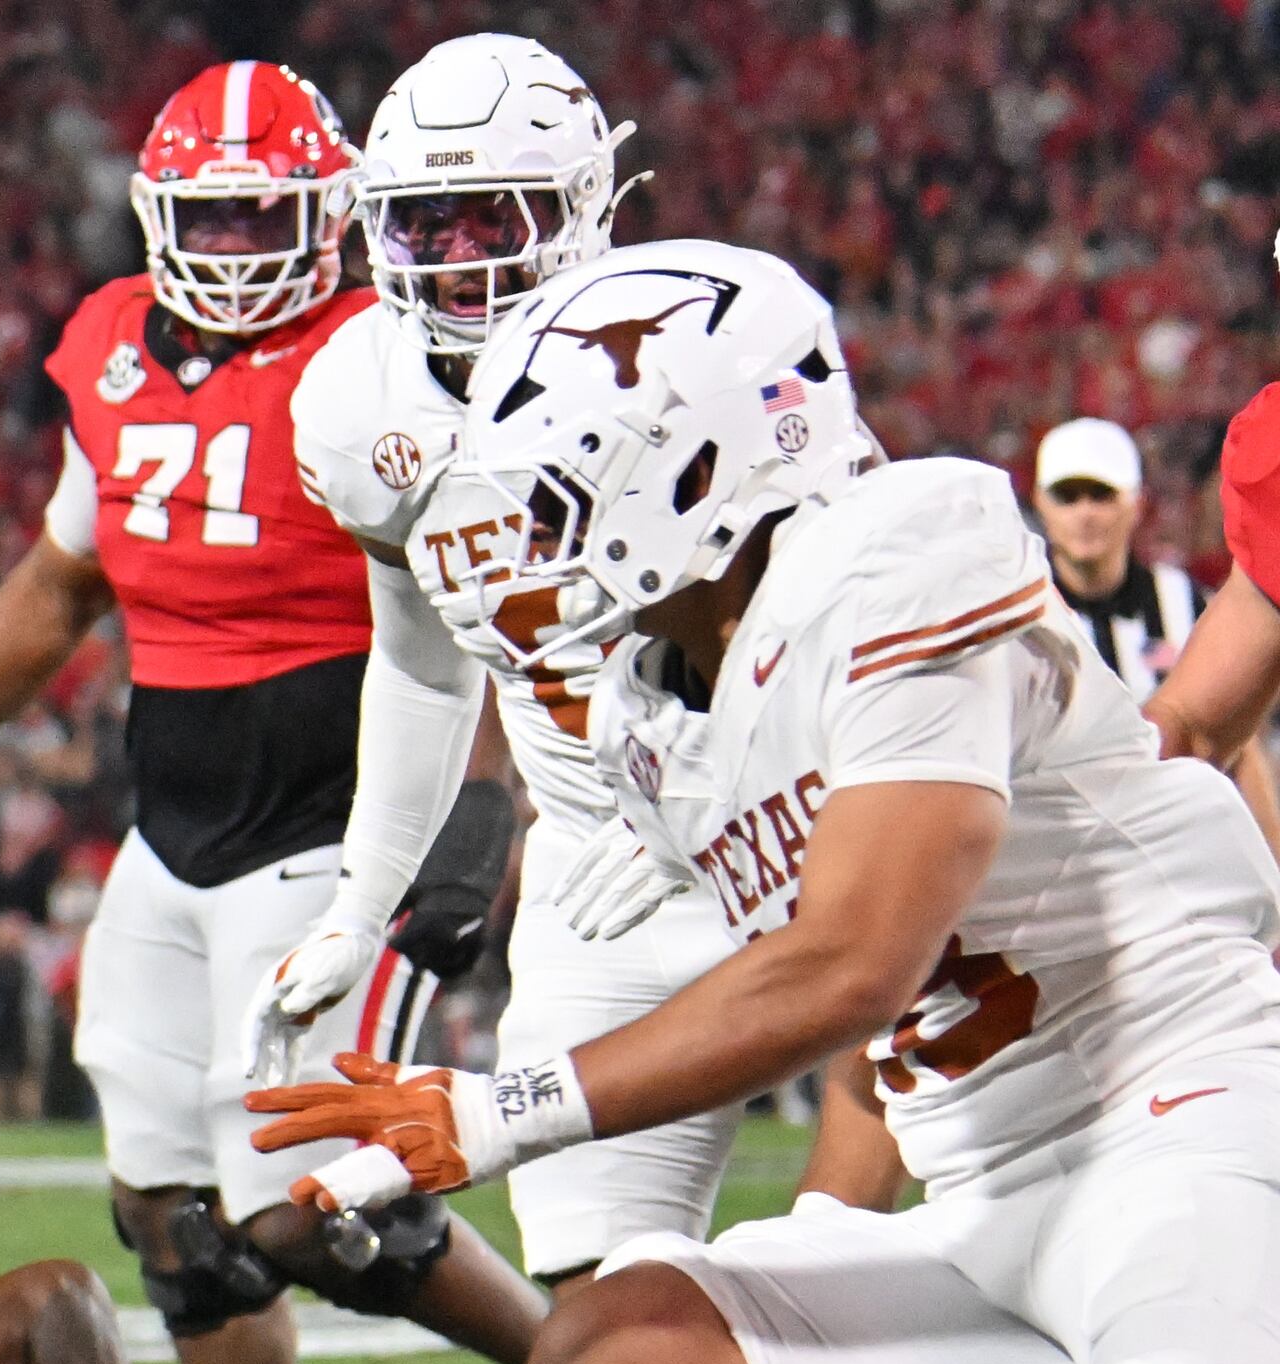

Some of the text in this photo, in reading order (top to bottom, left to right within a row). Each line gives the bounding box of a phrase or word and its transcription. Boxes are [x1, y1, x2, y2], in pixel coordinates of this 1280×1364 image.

[425, 150, 474, 168] HORNS
[776, 413, 809, 453] SEC
[111, 422, 262, 547] 71
[373, 432, 422, 489] SEC
